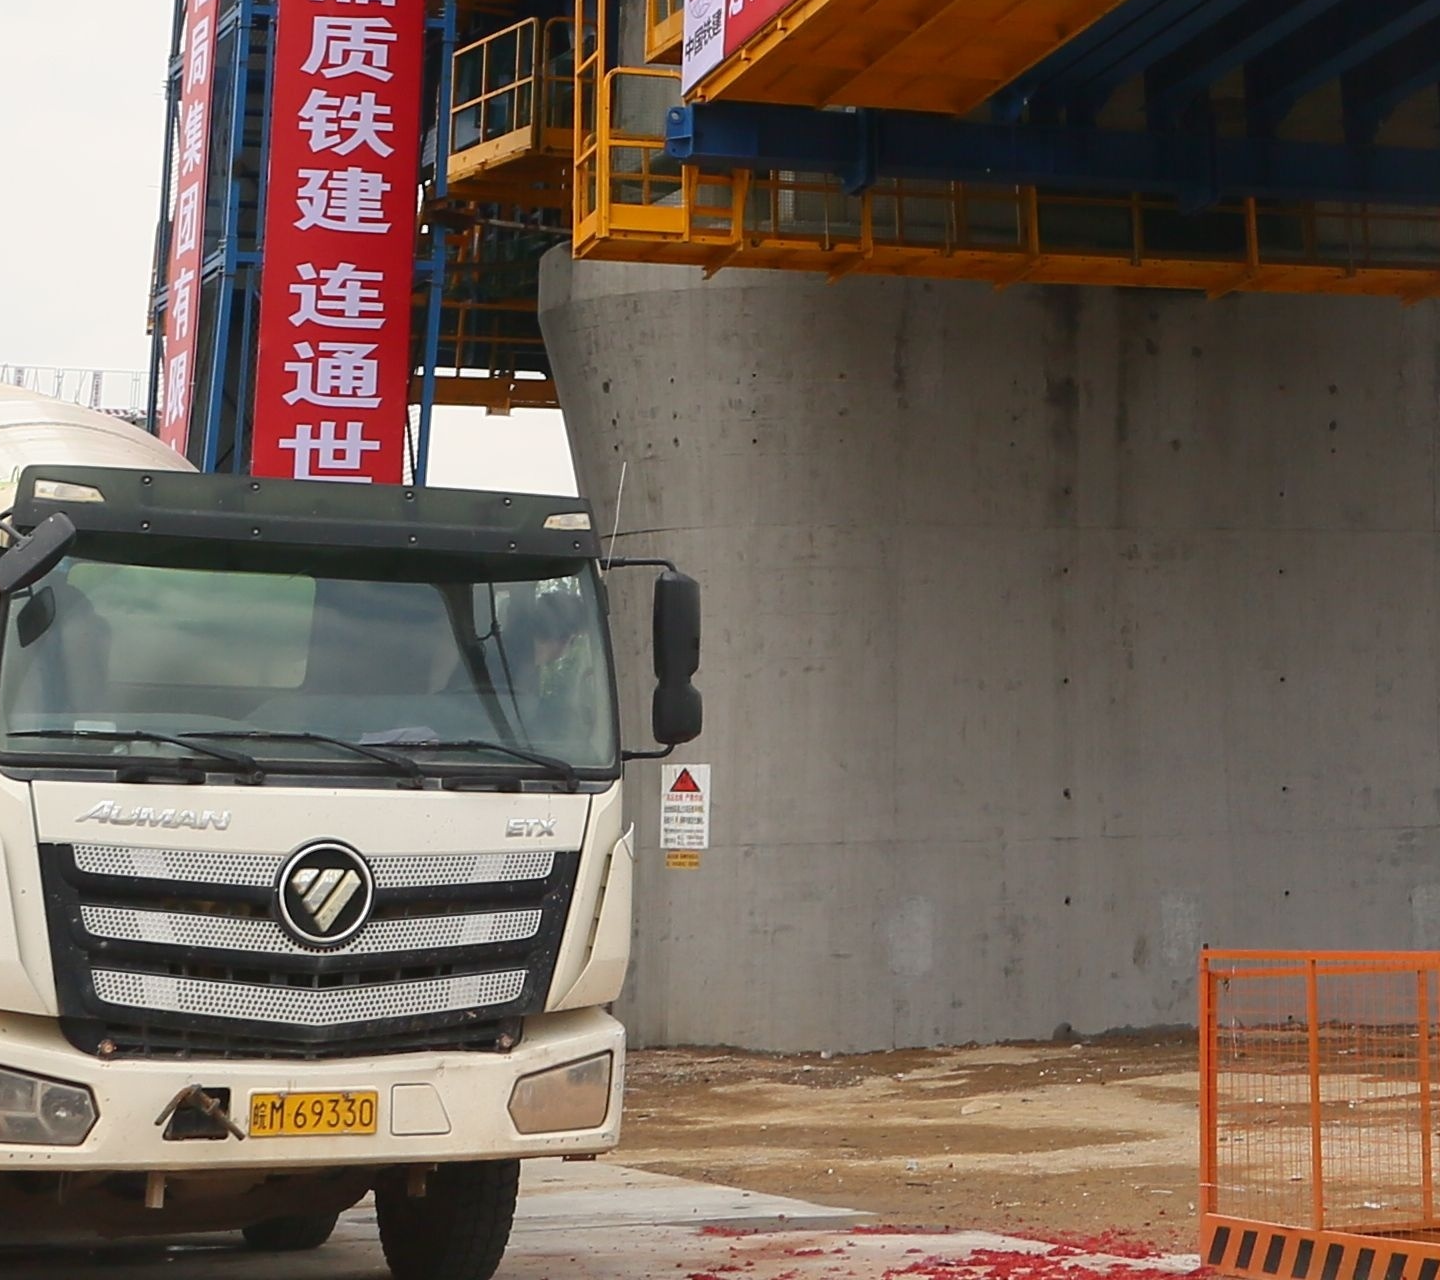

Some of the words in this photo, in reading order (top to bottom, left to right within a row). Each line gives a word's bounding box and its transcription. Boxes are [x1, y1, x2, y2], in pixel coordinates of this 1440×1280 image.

[685, 7, 723, 62] 中国铁建
[75, 800, 232, 830] AUMAN
[505, 817, 557, 838] ETX
